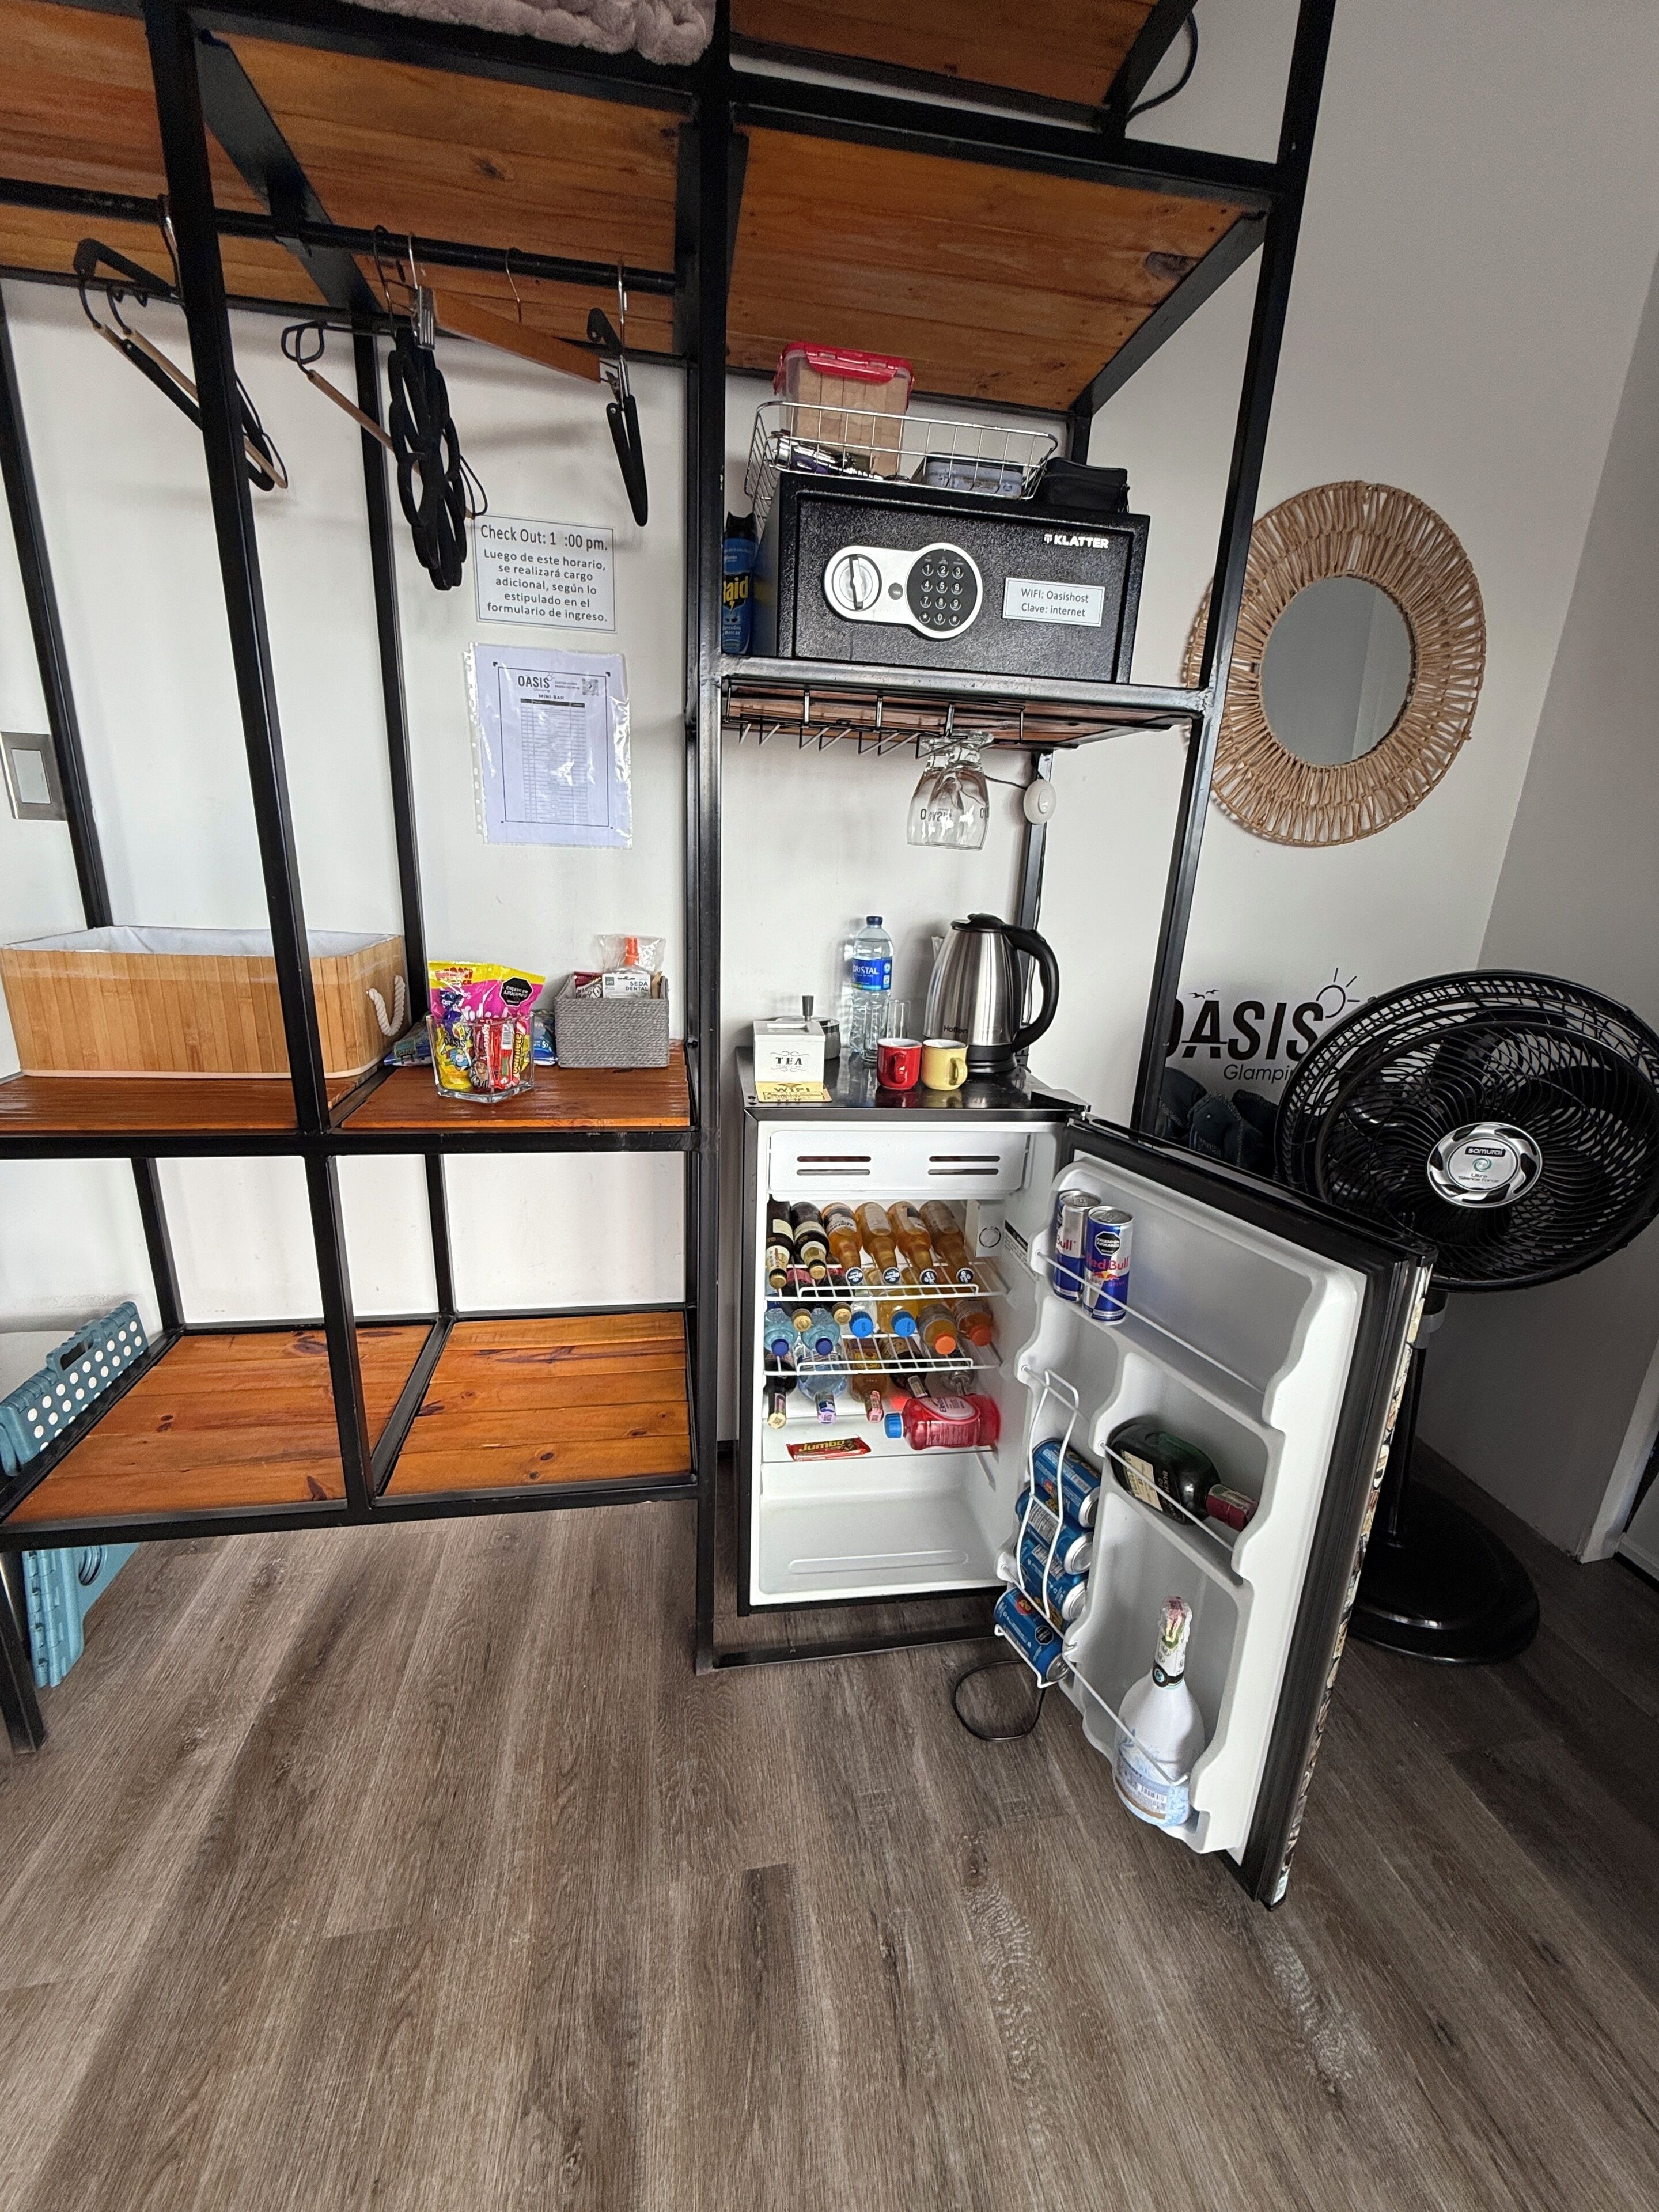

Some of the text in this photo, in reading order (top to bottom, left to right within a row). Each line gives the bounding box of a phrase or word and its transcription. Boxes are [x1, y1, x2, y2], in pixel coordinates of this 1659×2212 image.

[481, 524, 517, 541] Check
[520, 529, 546, 544] Out:
[586, 539, 608, 552] pm.
[1054, 535, 1109, 549] KLATTER
[484, 549, 605, 571] Luego de este horario,
[498, 565, 593, 581] se realizará cargo
[495, 577, 597, 594] adicional, según lo
[504, 592, 590, 608] estipulado en el
[1021, 588, 1089, 603] WIFI: Oasishost
[487, 602, 607, 622] formulario de ingreso.
[1021, 603, 1085, 617] Clave: internet
[518, 676, 550, 688] OASIS
[853, 965, 880, 975] CRISTAL
[775, 1057, 802, 1065] TEA
[1224, 1064, 1294, 1084] Glampi
[1468, 1147, 1502, 1156] samurai
[1108, 1256, 1129, 1270] Bull
[798, 1440, 845, 1453] Jumbo
